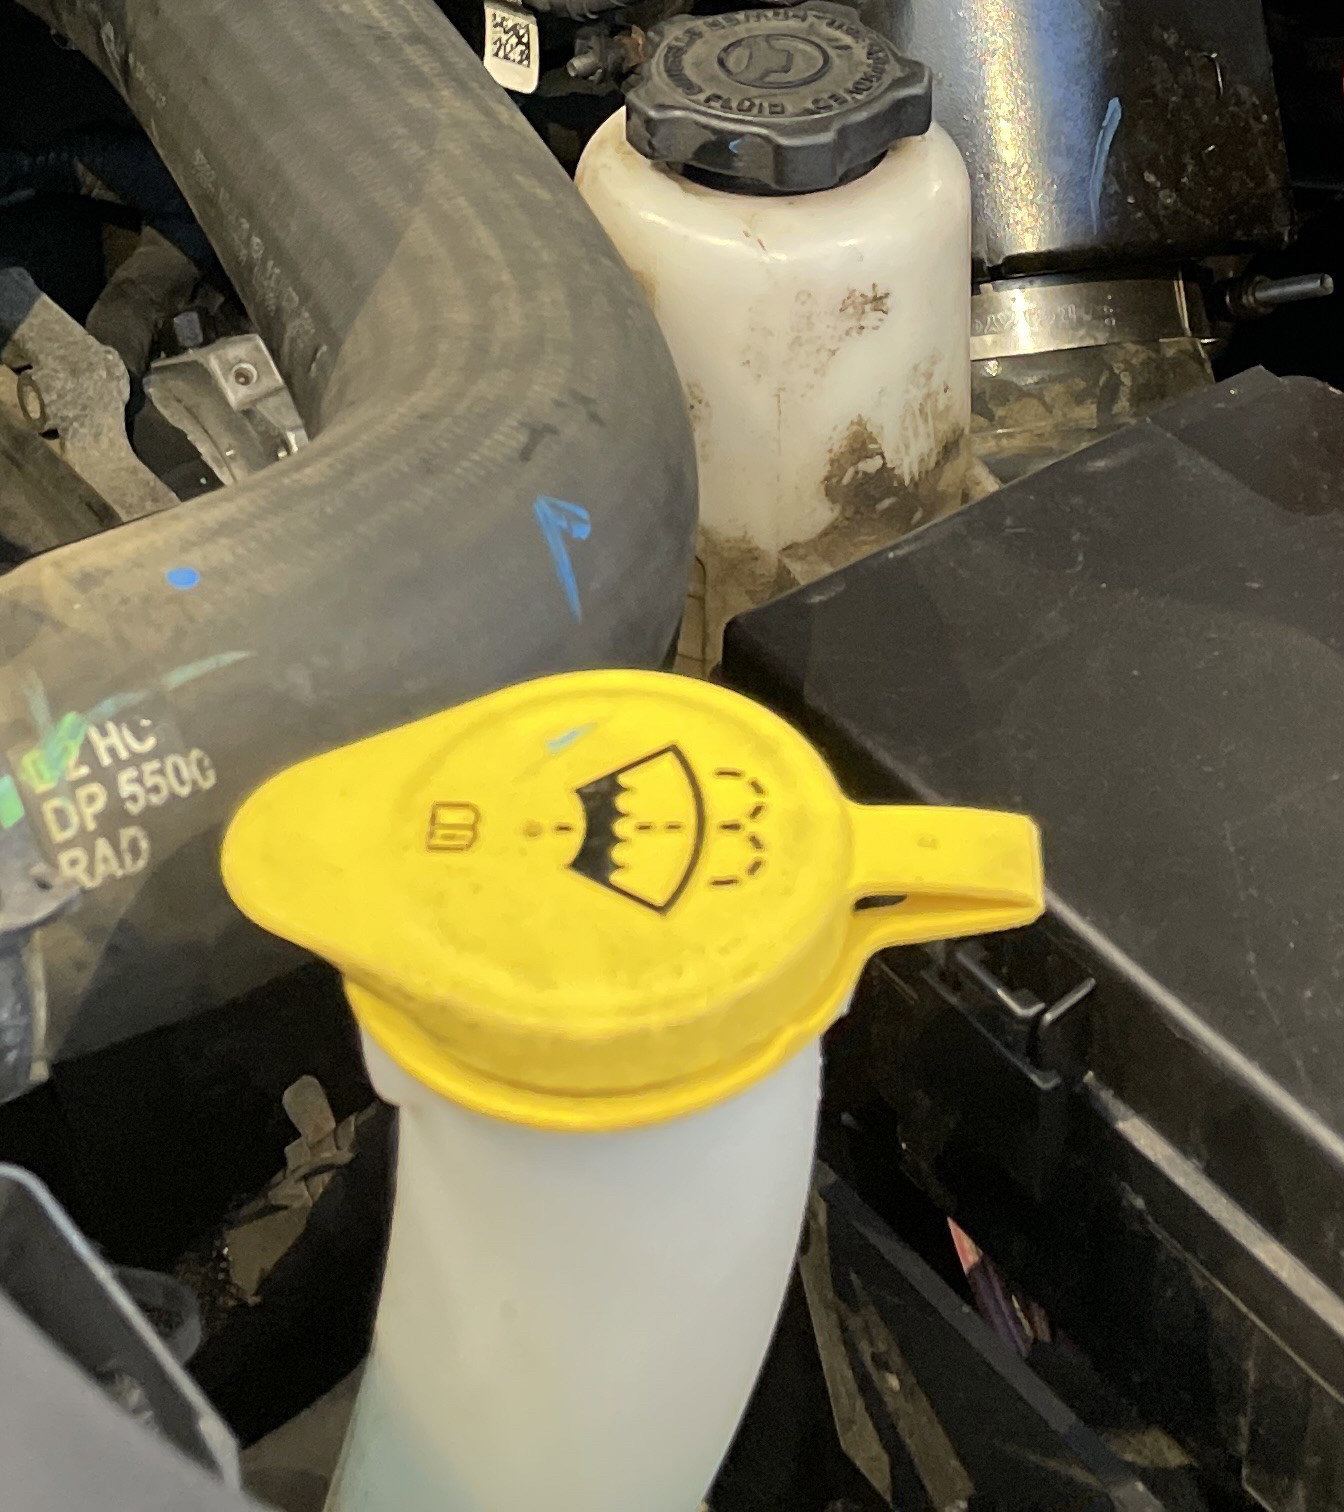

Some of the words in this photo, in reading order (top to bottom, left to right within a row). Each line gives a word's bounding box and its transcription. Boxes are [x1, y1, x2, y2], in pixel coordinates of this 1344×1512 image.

[40, 781, 109, 845] DP
[116, 747, 218, 817] 5500
[56, 825, 151, 890] RAD
